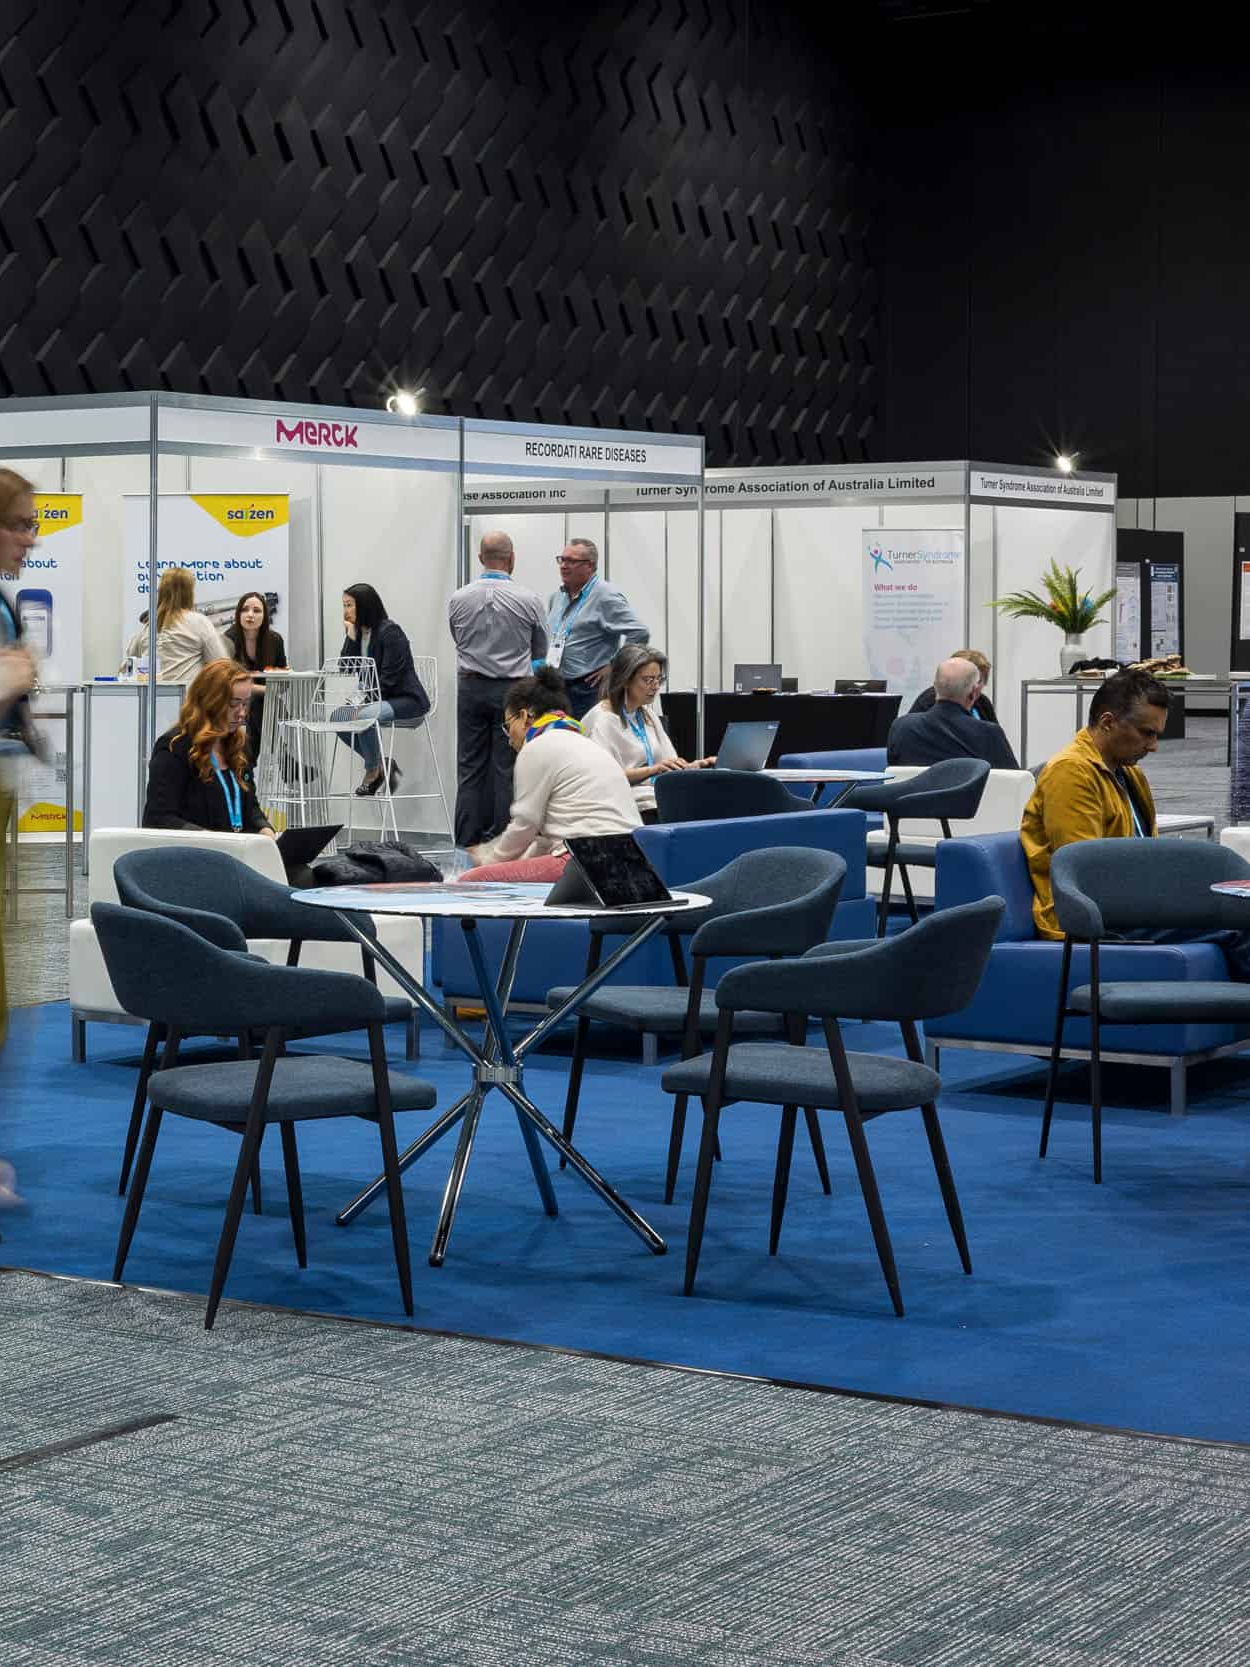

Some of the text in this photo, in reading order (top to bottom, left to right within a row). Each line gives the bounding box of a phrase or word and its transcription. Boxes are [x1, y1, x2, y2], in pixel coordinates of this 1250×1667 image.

[525, 442, 647, 463] RECORDATI RARE DISEASES
[738, 480, 810, 494] Association
[813, 480, 826, 491] of
[828, 477, 884, 491] Australia
[888, 477, 935, 490] Limited
[224, 558, 263, 569] about
